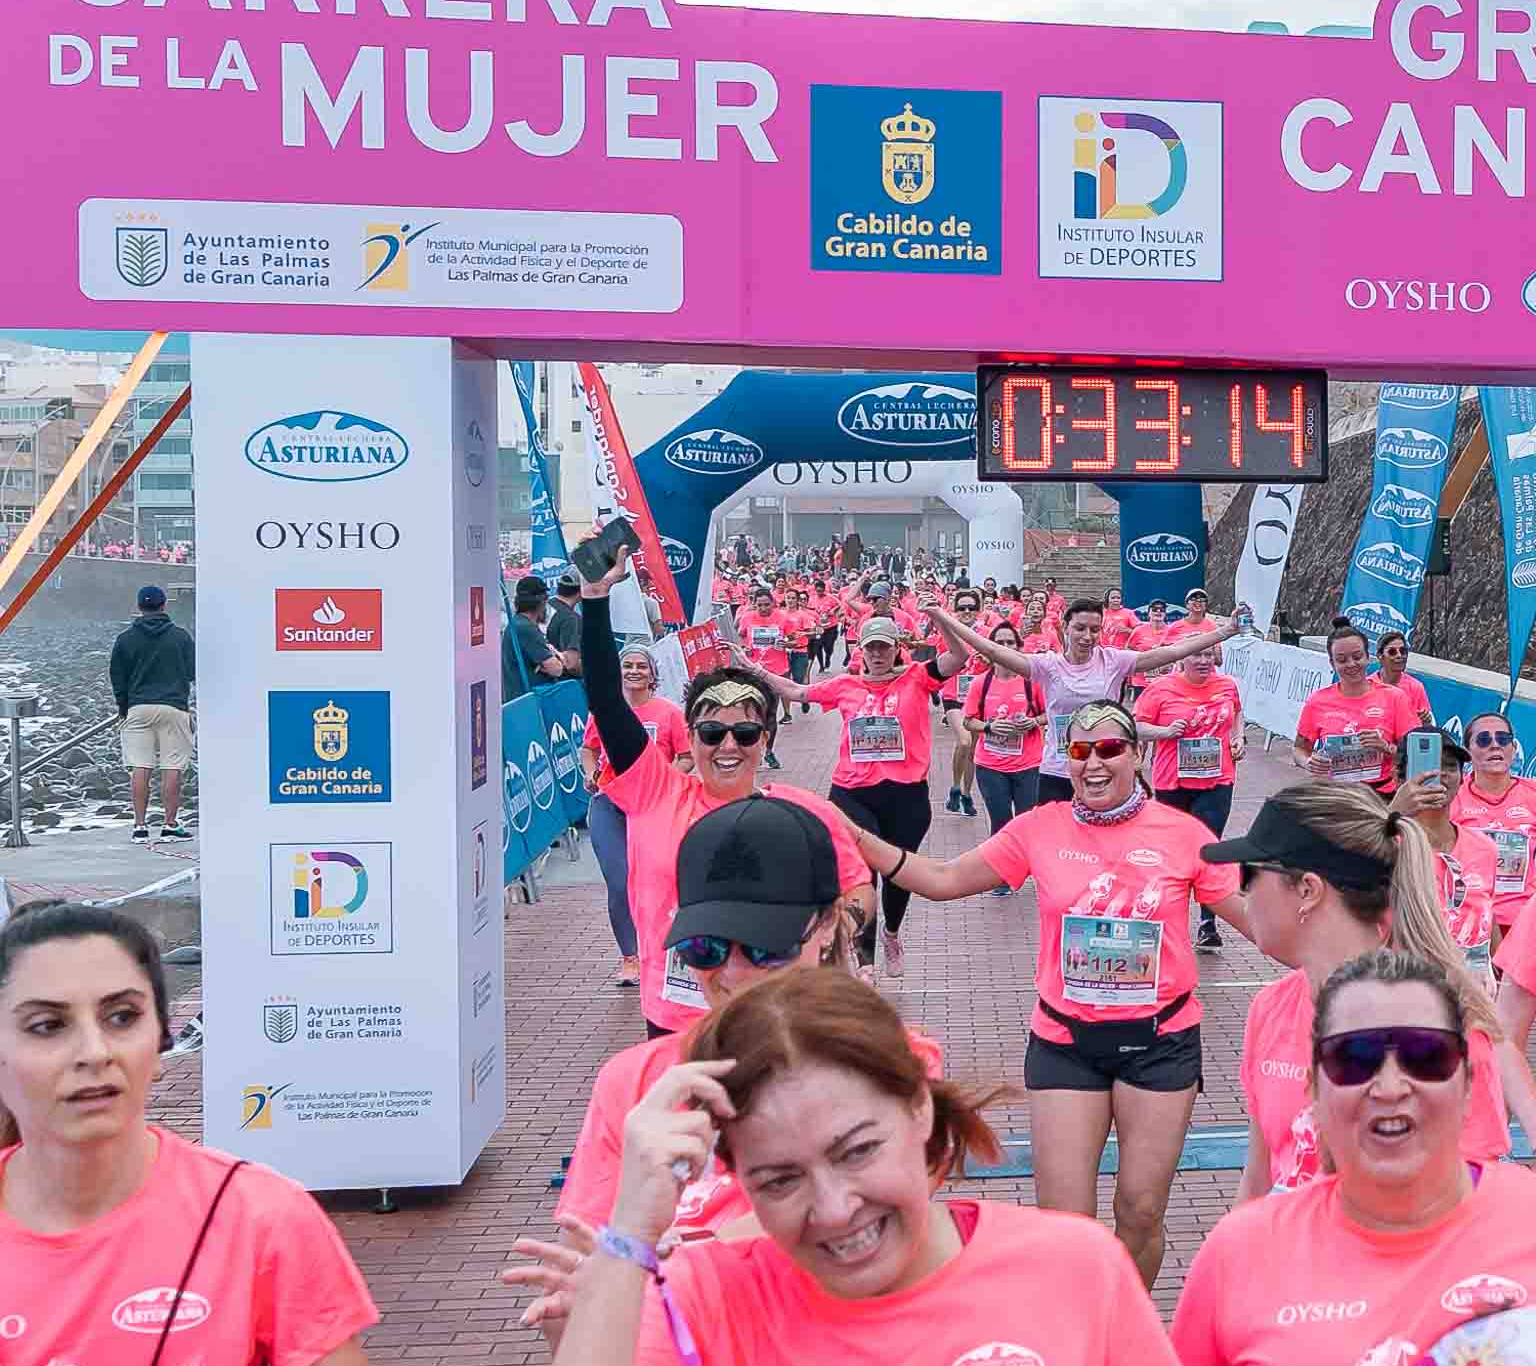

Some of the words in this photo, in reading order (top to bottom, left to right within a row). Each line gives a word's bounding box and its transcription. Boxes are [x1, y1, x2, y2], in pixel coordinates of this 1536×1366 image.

[49, 33, 141, 89] DE
[166, 36, 259, 92] LA
[280, 41, 780, 163] MUJER
[837, 211, 934, 237] Cabildo
[940, 215, 972, 238] de
[1057, 222, 1135, 243] INSTITUTO
[1140, 224, 1205, 245] INSULAR
[183, 232, 330, 252] Ayuntamiento
[426, 238, 475, 251] Instituto
[478, 240, 537, 254] Municipal
[540, 243, 568, 255] para
[571, 242, 581, 253] la
[584, 243, 649, 256] Promoción
[825, 236, 887, 259] Gran
[892, 238, 989, 263] Canaria
[183, 251, 207, 266] de
[219, 252, 250, 267] Las
[262, 253, 331, 269] Palmas
[427, 253, 444, 265] de
[446, 254, 458, 265] la
[460, 254, 517, 267] Actividad
[566, 257, 578, 268] el
[580, 258, 629, 271] Deporte
[632, 258, 648, 270] de
[1064, 249, 1085, 266] DE
[1089, 246, 1197, 268] DEPORTES
[183, 269, 207, 284] de
[211, 270, 255, 285] Gran
[261, 270, 331, 287] Canaria
[447, 269, 470, 282] Las
[472, 269, 519, 284] Palmas
[521, 271, 540, 284] de
[542, 271, 576, 285] Gran
[578, 271, 629, 286] Canaria
[1344, 278, 1492, 315] OYSHO
[257, 436, 398, 465] ASTURIANA
[670, 446, 755, 466] ASTURIANA
[772, 460, 913, 485] OYSHO
[952, 484, 994, 495] OYSHO
[255, 520, 402, 551] OYSHO
[975, 540, 1016, 551] OYSHO
[1128, 547, 1196, 564] ASTURIANA
[283, 626, 375, 643] Santander
[286, 766, 348, 781] Cabildo
[351, 767, 372, 781] de
[279, 782, 318, 795] Gran
[321, 781, 383, 795] Canaria
[304, 933, 376, 947] DEPORTES
[1092, 957, 1128, 973] 112
[306, 1004, 402, 1019] Ayuntamiento
[307, 1018, 323, 1028] de
[330, 1018, 351, 1027] Las
[357, 1016, 402, 1027] Palmas
[307, 1030, 322, 1040] de
[325, 1030, 354, 1040] Gran
[357, 1027, 402, 1039] Canaria
[1275, 1298, 1369, 1327] OYSHO
